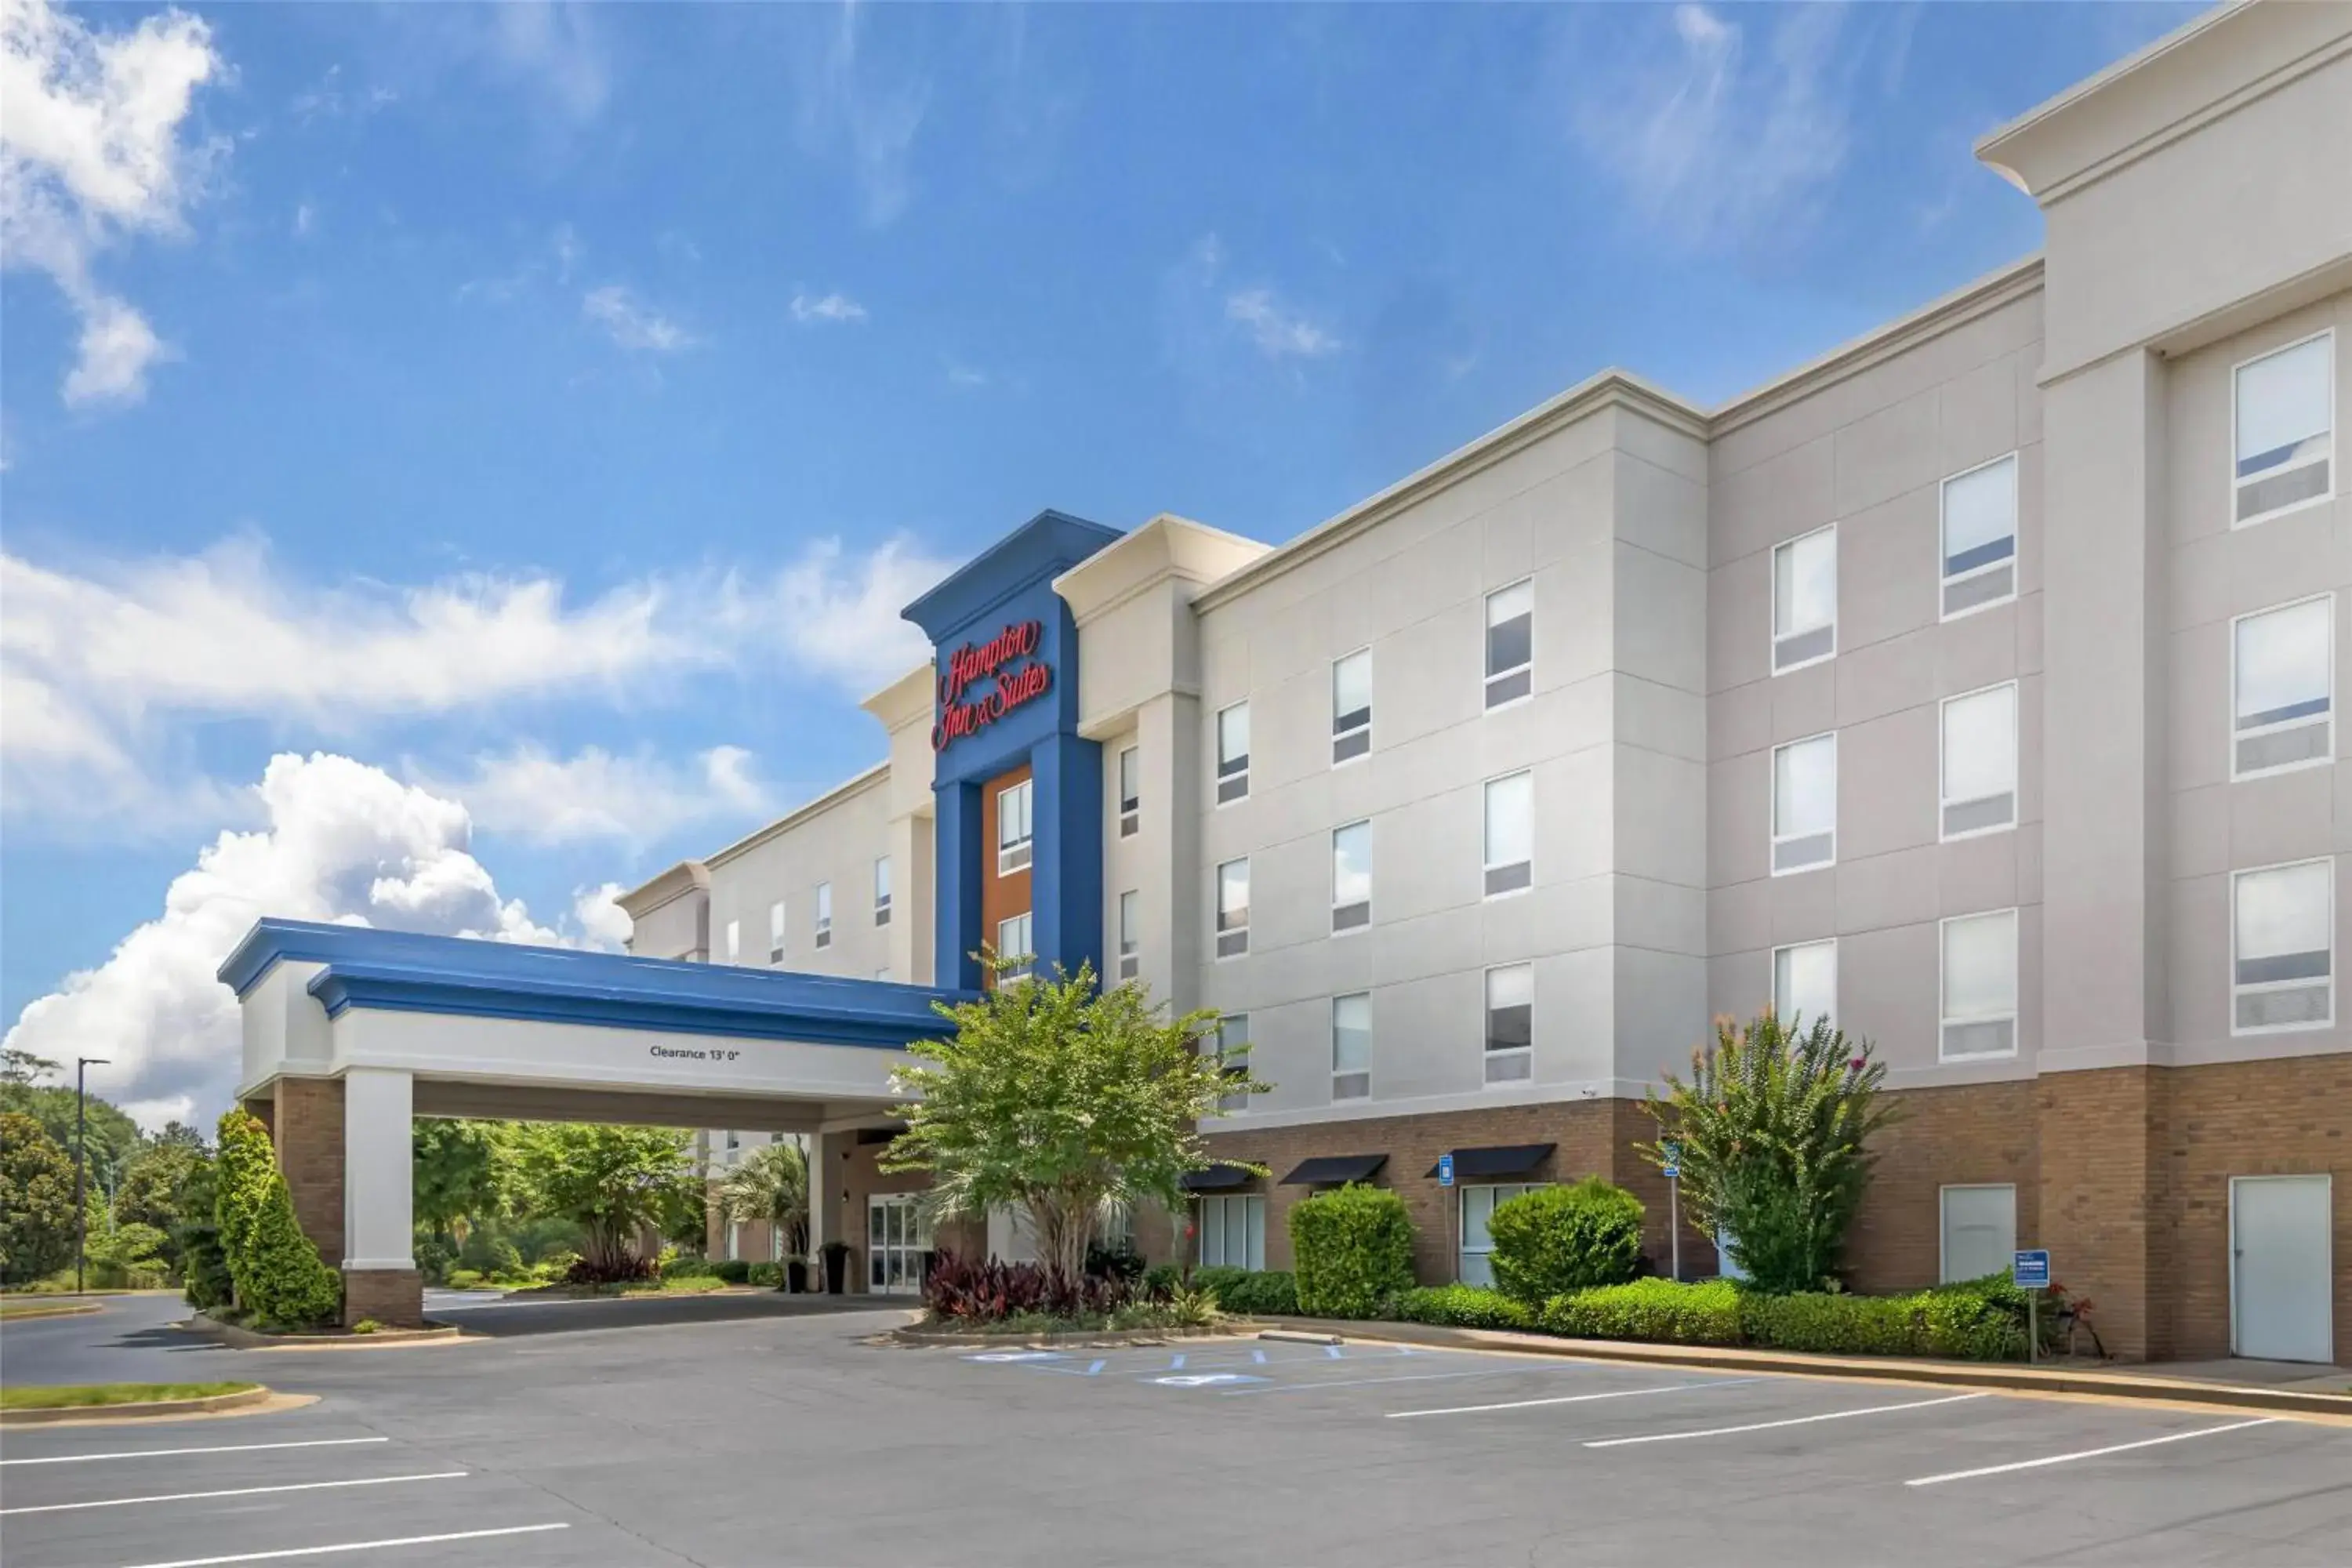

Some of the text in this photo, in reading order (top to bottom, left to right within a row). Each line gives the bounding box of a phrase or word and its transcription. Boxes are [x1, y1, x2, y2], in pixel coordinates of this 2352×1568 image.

[938, 620, 1042, 706] Hampton
[931, 703, 978, 751] Inn
[990, 663, 1049, 717] Suites
[650, 1046, 706, 1059] Clearance
[710, 1050, 725, 1060] 13'
